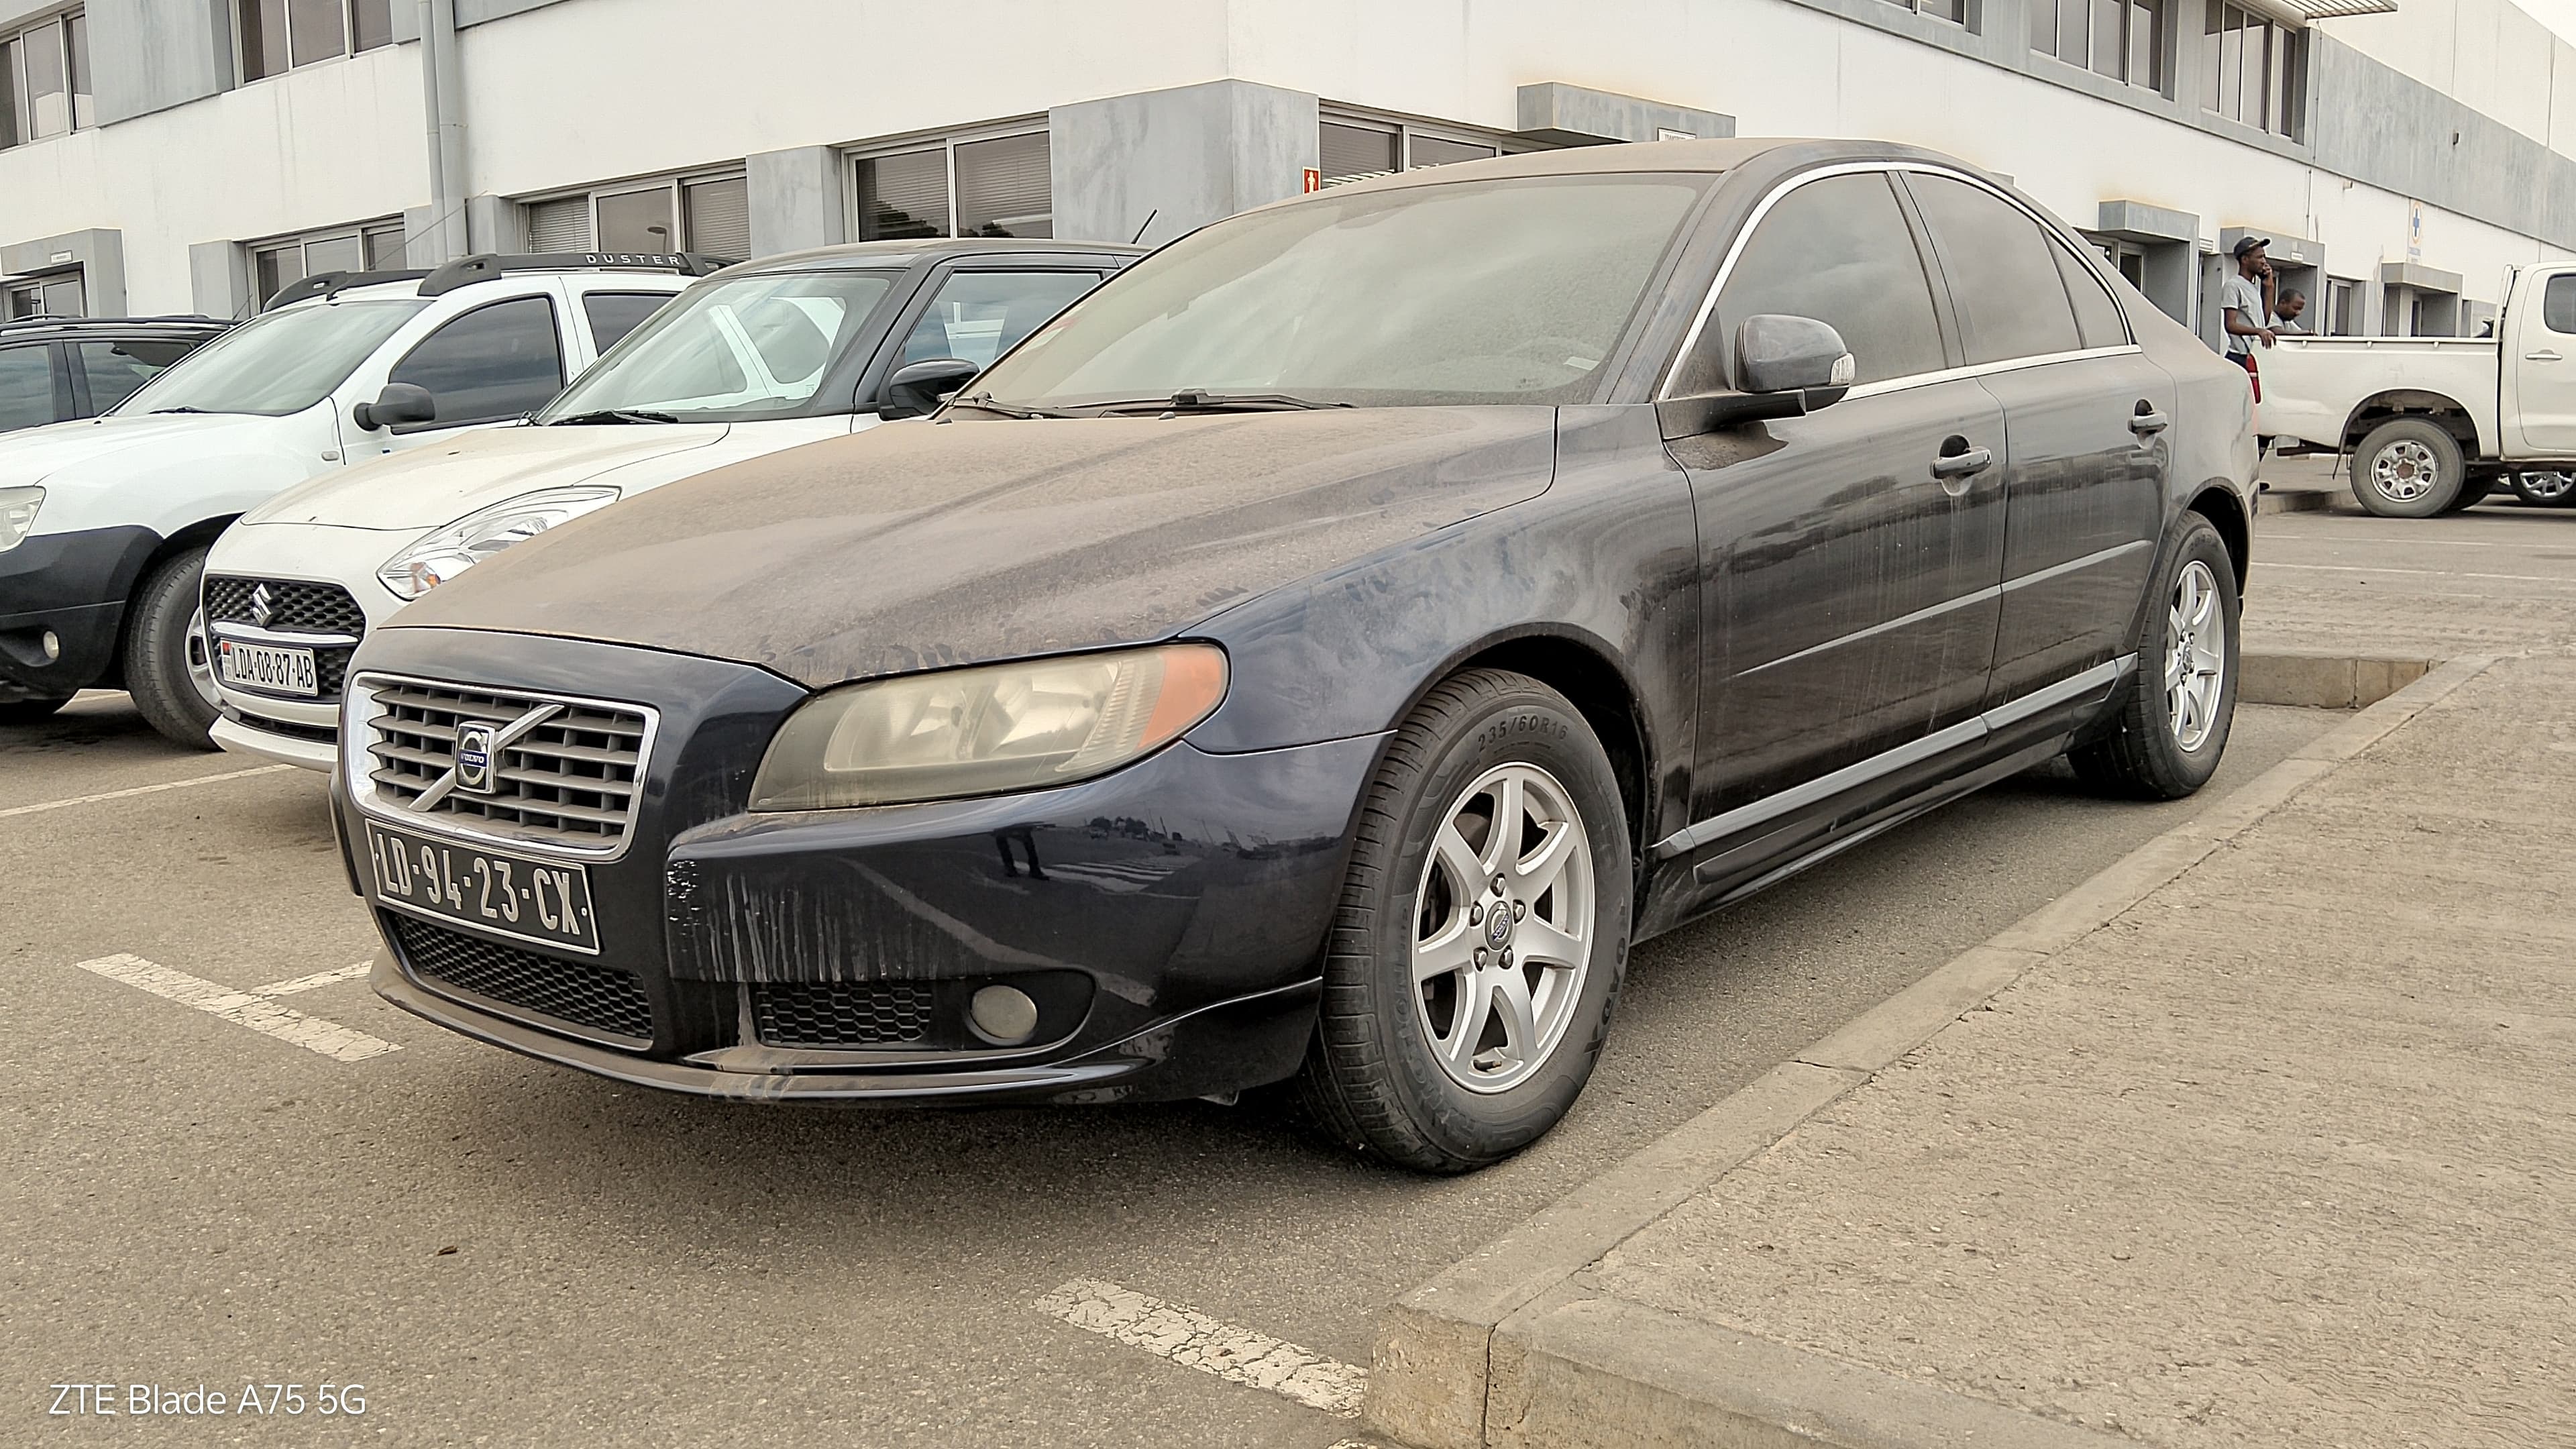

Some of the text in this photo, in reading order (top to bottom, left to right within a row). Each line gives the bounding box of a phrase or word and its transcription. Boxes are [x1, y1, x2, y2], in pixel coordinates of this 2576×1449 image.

[586, 254, 680, 265] DUSTER
[1478, 715, 1568, 753] 235/60R16
[461, 753, 484, 763] VOLVO
